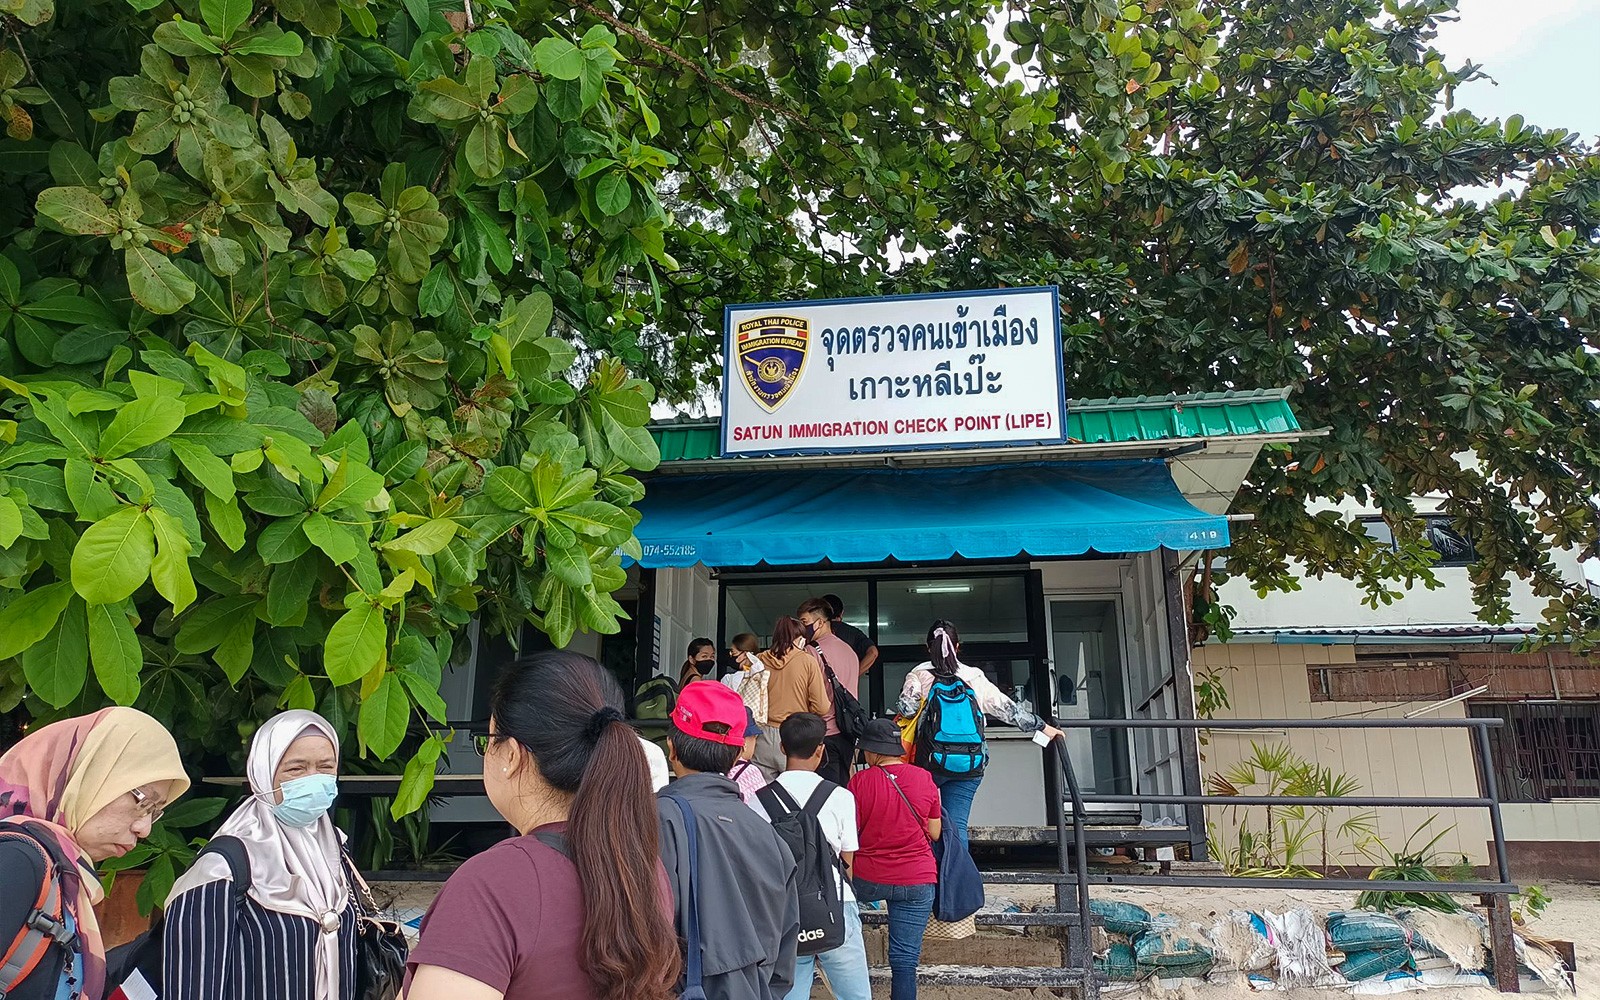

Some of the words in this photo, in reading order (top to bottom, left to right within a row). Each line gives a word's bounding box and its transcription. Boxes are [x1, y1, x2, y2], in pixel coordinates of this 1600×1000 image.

[741, 321, 763, 330] ROYAL
[764, 318, 779, 326] THAI
[780, 318, 805, 328] POLICE
[820, 304, 1039, 372] จุดตรวจคนเข้าเมือง
[740, 337, 780, 350] IMMIGRATION
[780, 337, 804, 348] BUREAU
[849, 354, 1003, 401] เกาะหลีเป๊ะ
[733, 425, 783, 441] SATUN
[788, 420, 889, 438] IMMIGRATION
[894, 417, 947, 433] CHECK
[955, 415, 1001, 431] POINT
[1005, 411, 1052, 429] (LIPE)
